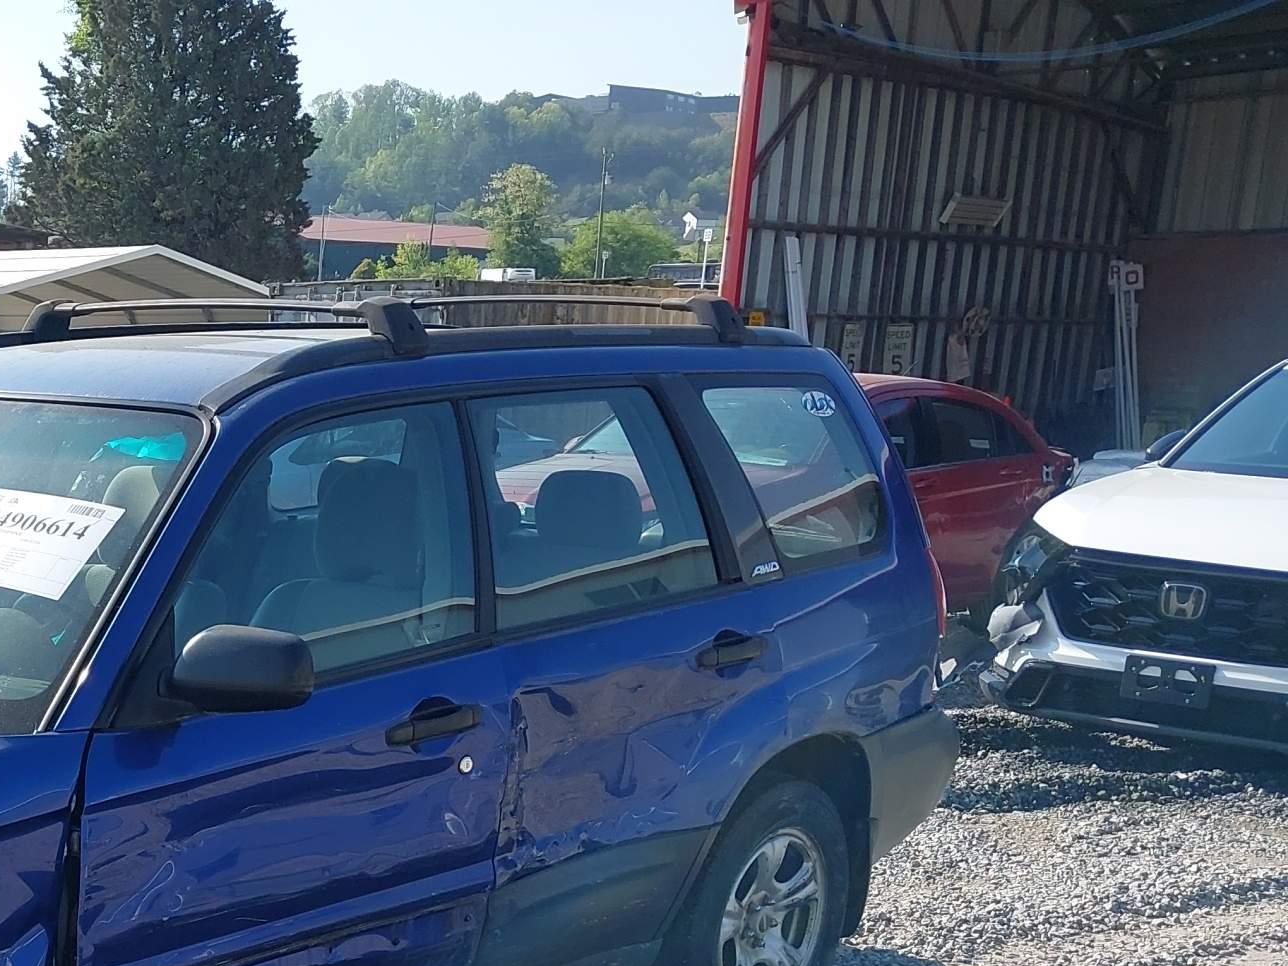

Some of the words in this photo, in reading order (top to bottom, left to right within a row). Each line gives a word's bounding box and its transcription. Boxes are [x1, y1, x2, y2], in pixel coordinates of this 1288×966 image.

[887, 342, 907, 352] LIMIT
[891, 354, 903, 374] 5
[751, 561, 780, 577] AWD
